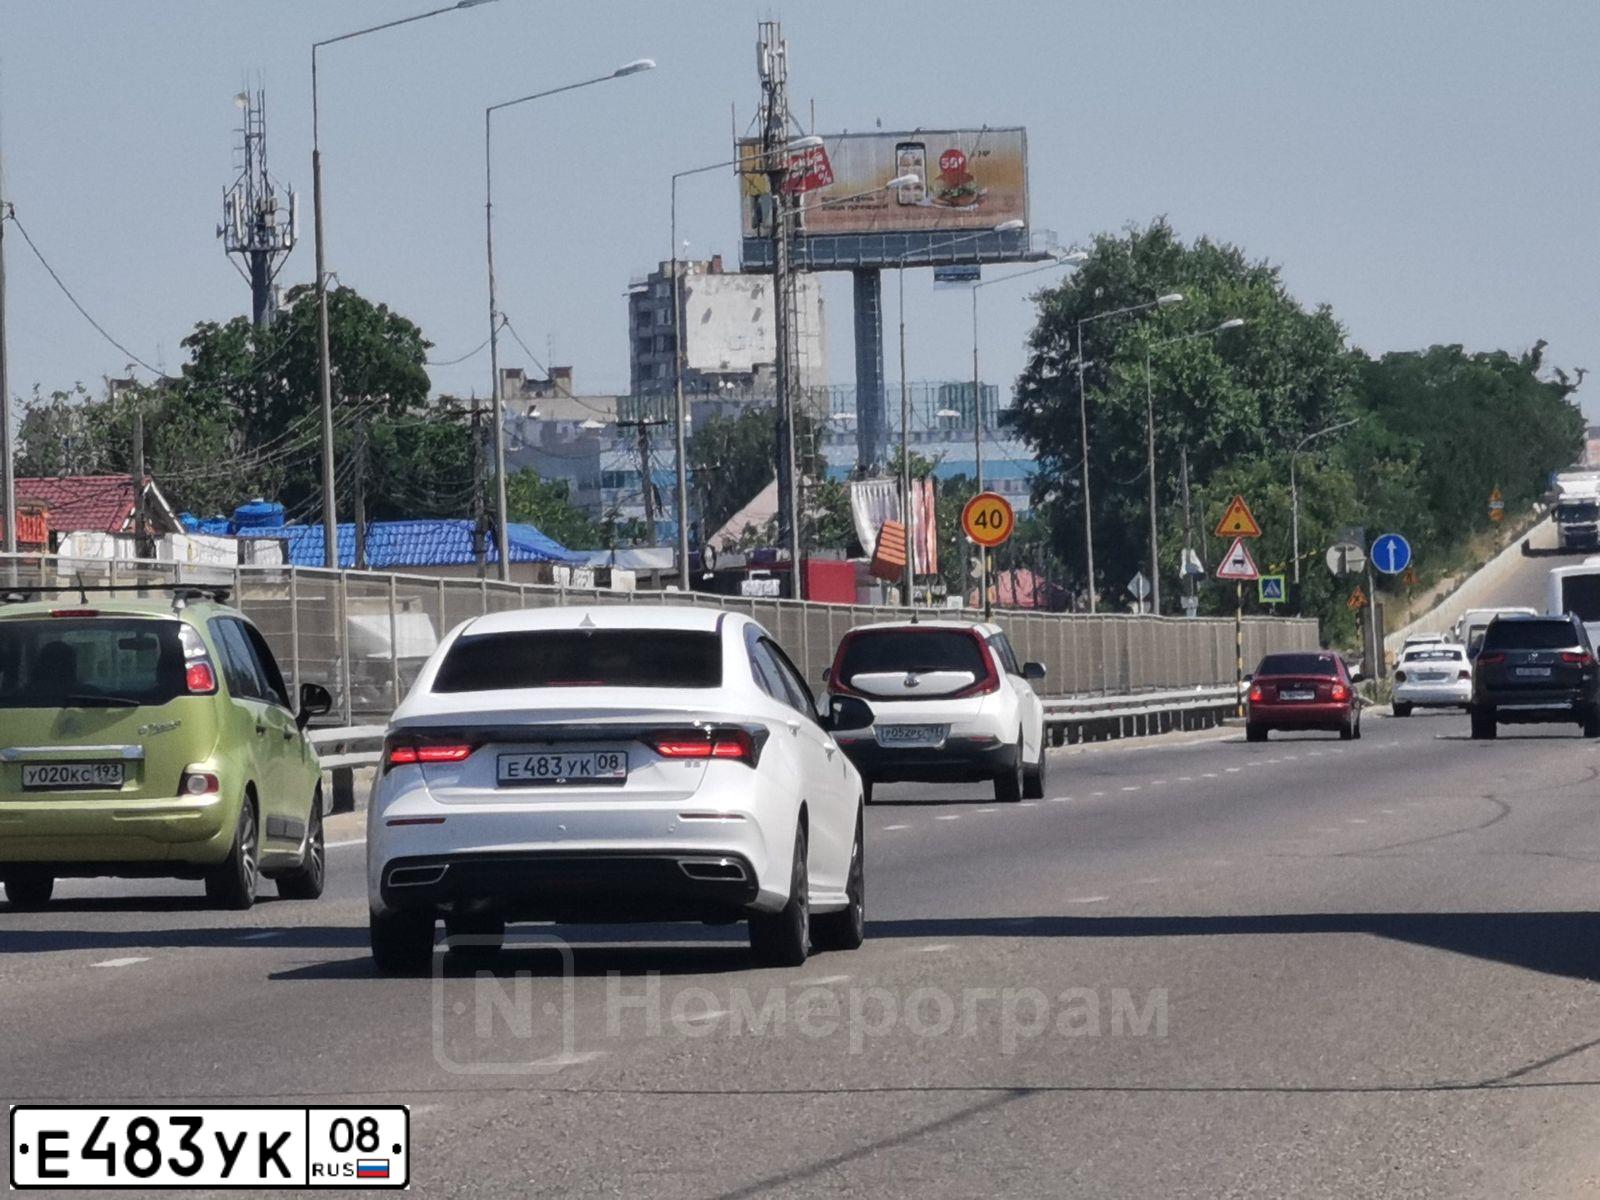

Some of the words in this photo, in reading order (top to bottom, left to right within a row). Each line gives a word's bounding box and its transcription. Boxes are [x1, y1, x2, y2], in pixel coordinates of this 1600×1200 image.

[974, 509, 1003, 529] 40
[28, 767, 91, 784] У020КС
[94, 765, 119, 778] 193
[507, 757, 591, 777] Е483УК
[597, 754, 619, 770] 08
